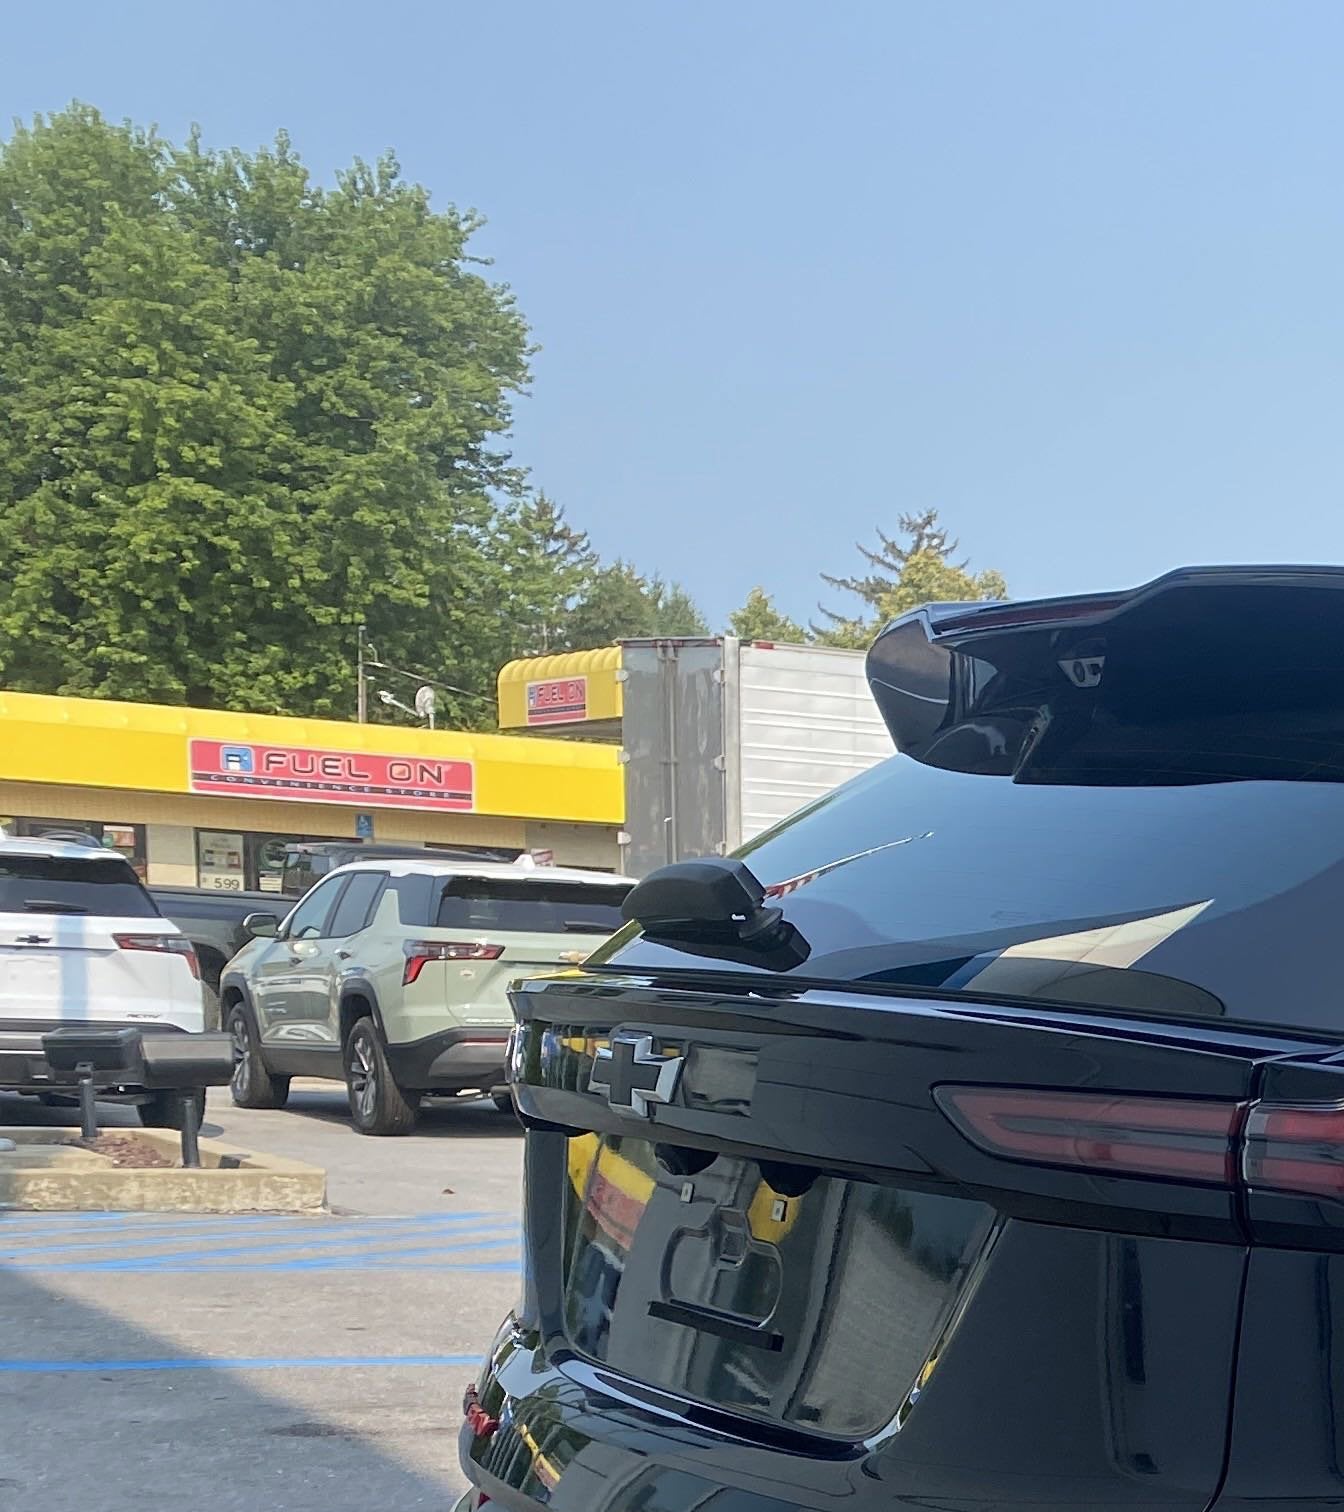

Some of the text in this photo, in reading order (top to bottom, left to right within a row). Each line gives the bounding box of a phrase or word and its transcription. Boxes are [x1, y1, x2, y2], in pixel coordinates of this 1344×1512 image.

[264, 751, 443, 785] FUEL ON
[209, 773, 451, 799] CONVENIENCE STORE
